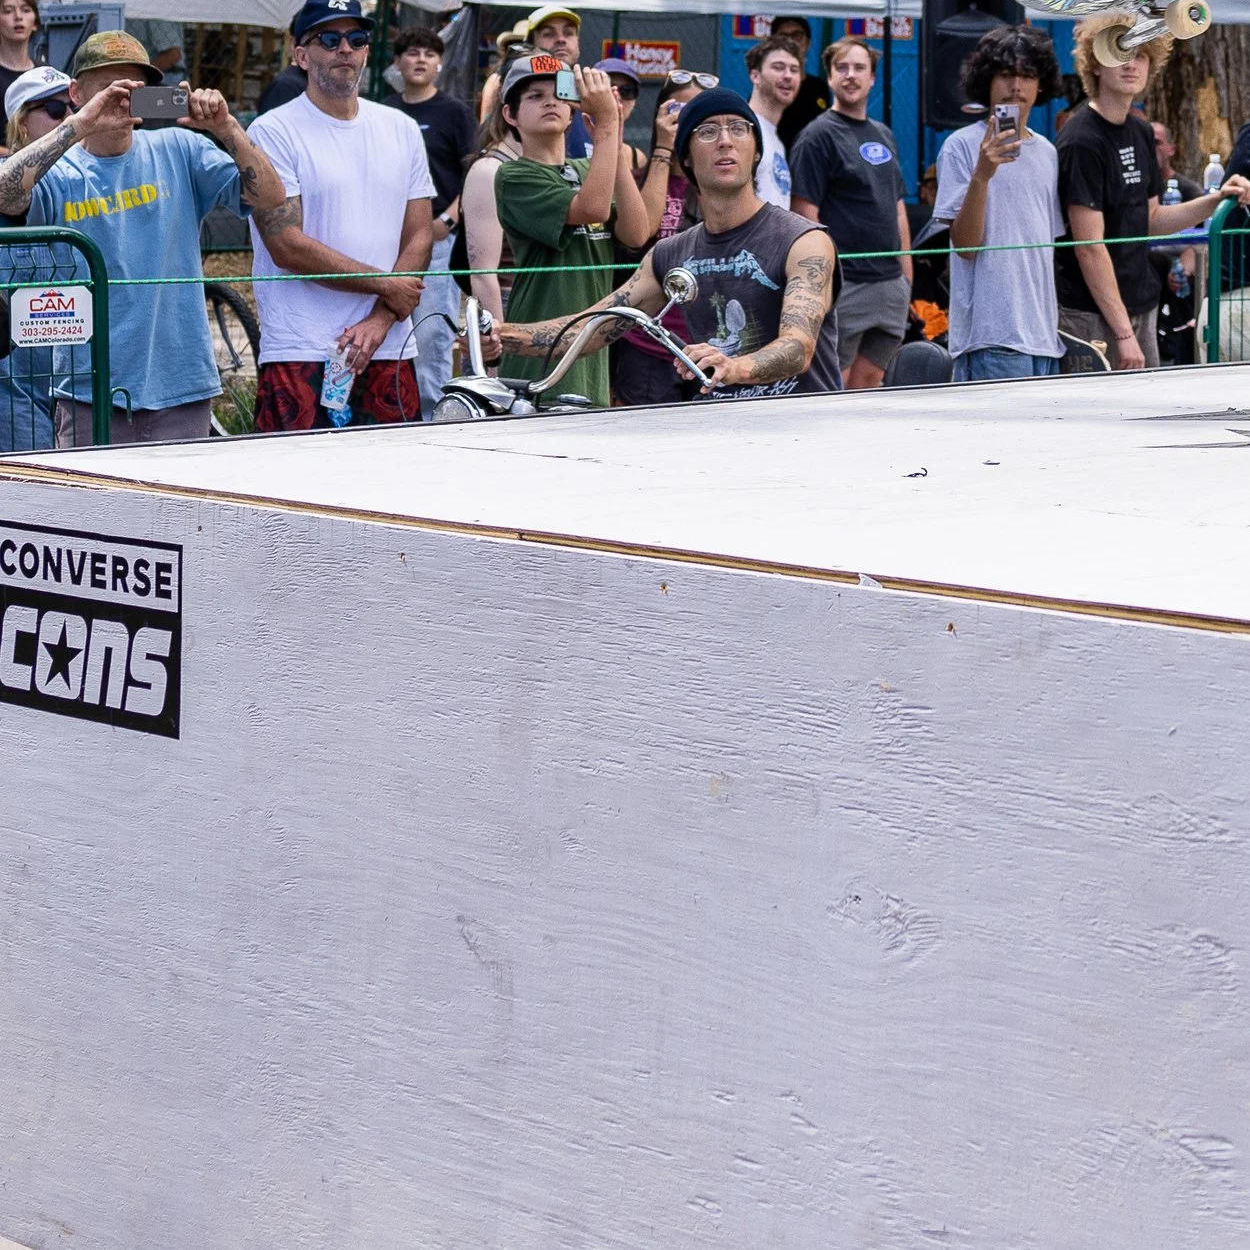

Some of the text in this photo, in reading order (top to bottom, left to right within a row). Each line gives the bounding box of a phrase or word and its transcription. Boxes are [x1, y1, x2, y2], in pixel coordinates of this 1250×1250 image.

[625, 42, 675, 64] Honey
[29, 297, 75, 312] CAM
[19, 336, 86, 345] www.CAMColorado.com
[22, 326, 82, 337] 303-295-2424
[0, 538, 172, 599] CONVERSE
[0, 605, 172, 717] CONS
